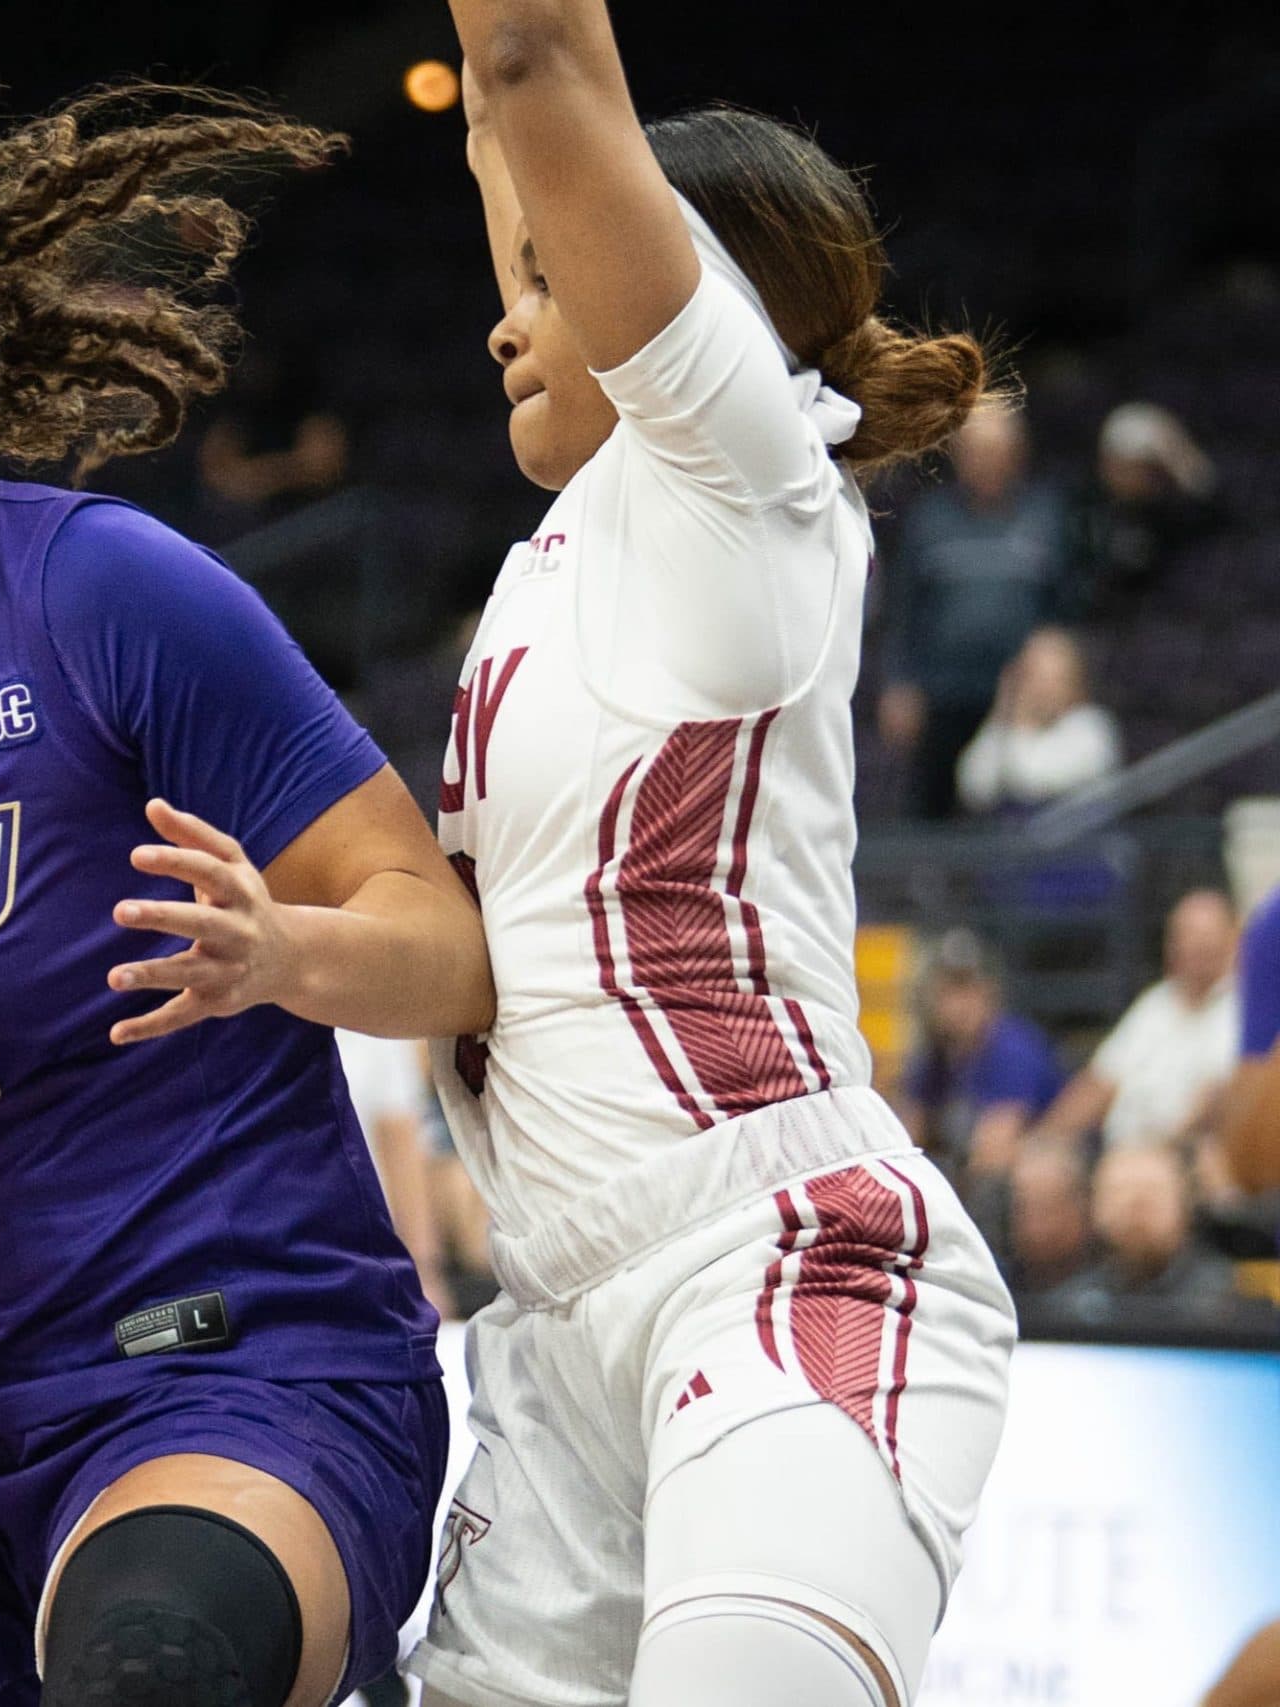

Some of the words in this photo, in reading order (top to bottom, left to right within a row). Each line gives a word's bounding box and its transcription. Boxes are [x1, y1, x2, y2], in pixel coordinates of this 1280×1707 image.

[437, 646, 531, 814] OY
[193, 1308, 209, 1330] L
[959, 1503, 1150, 1628] UTE
